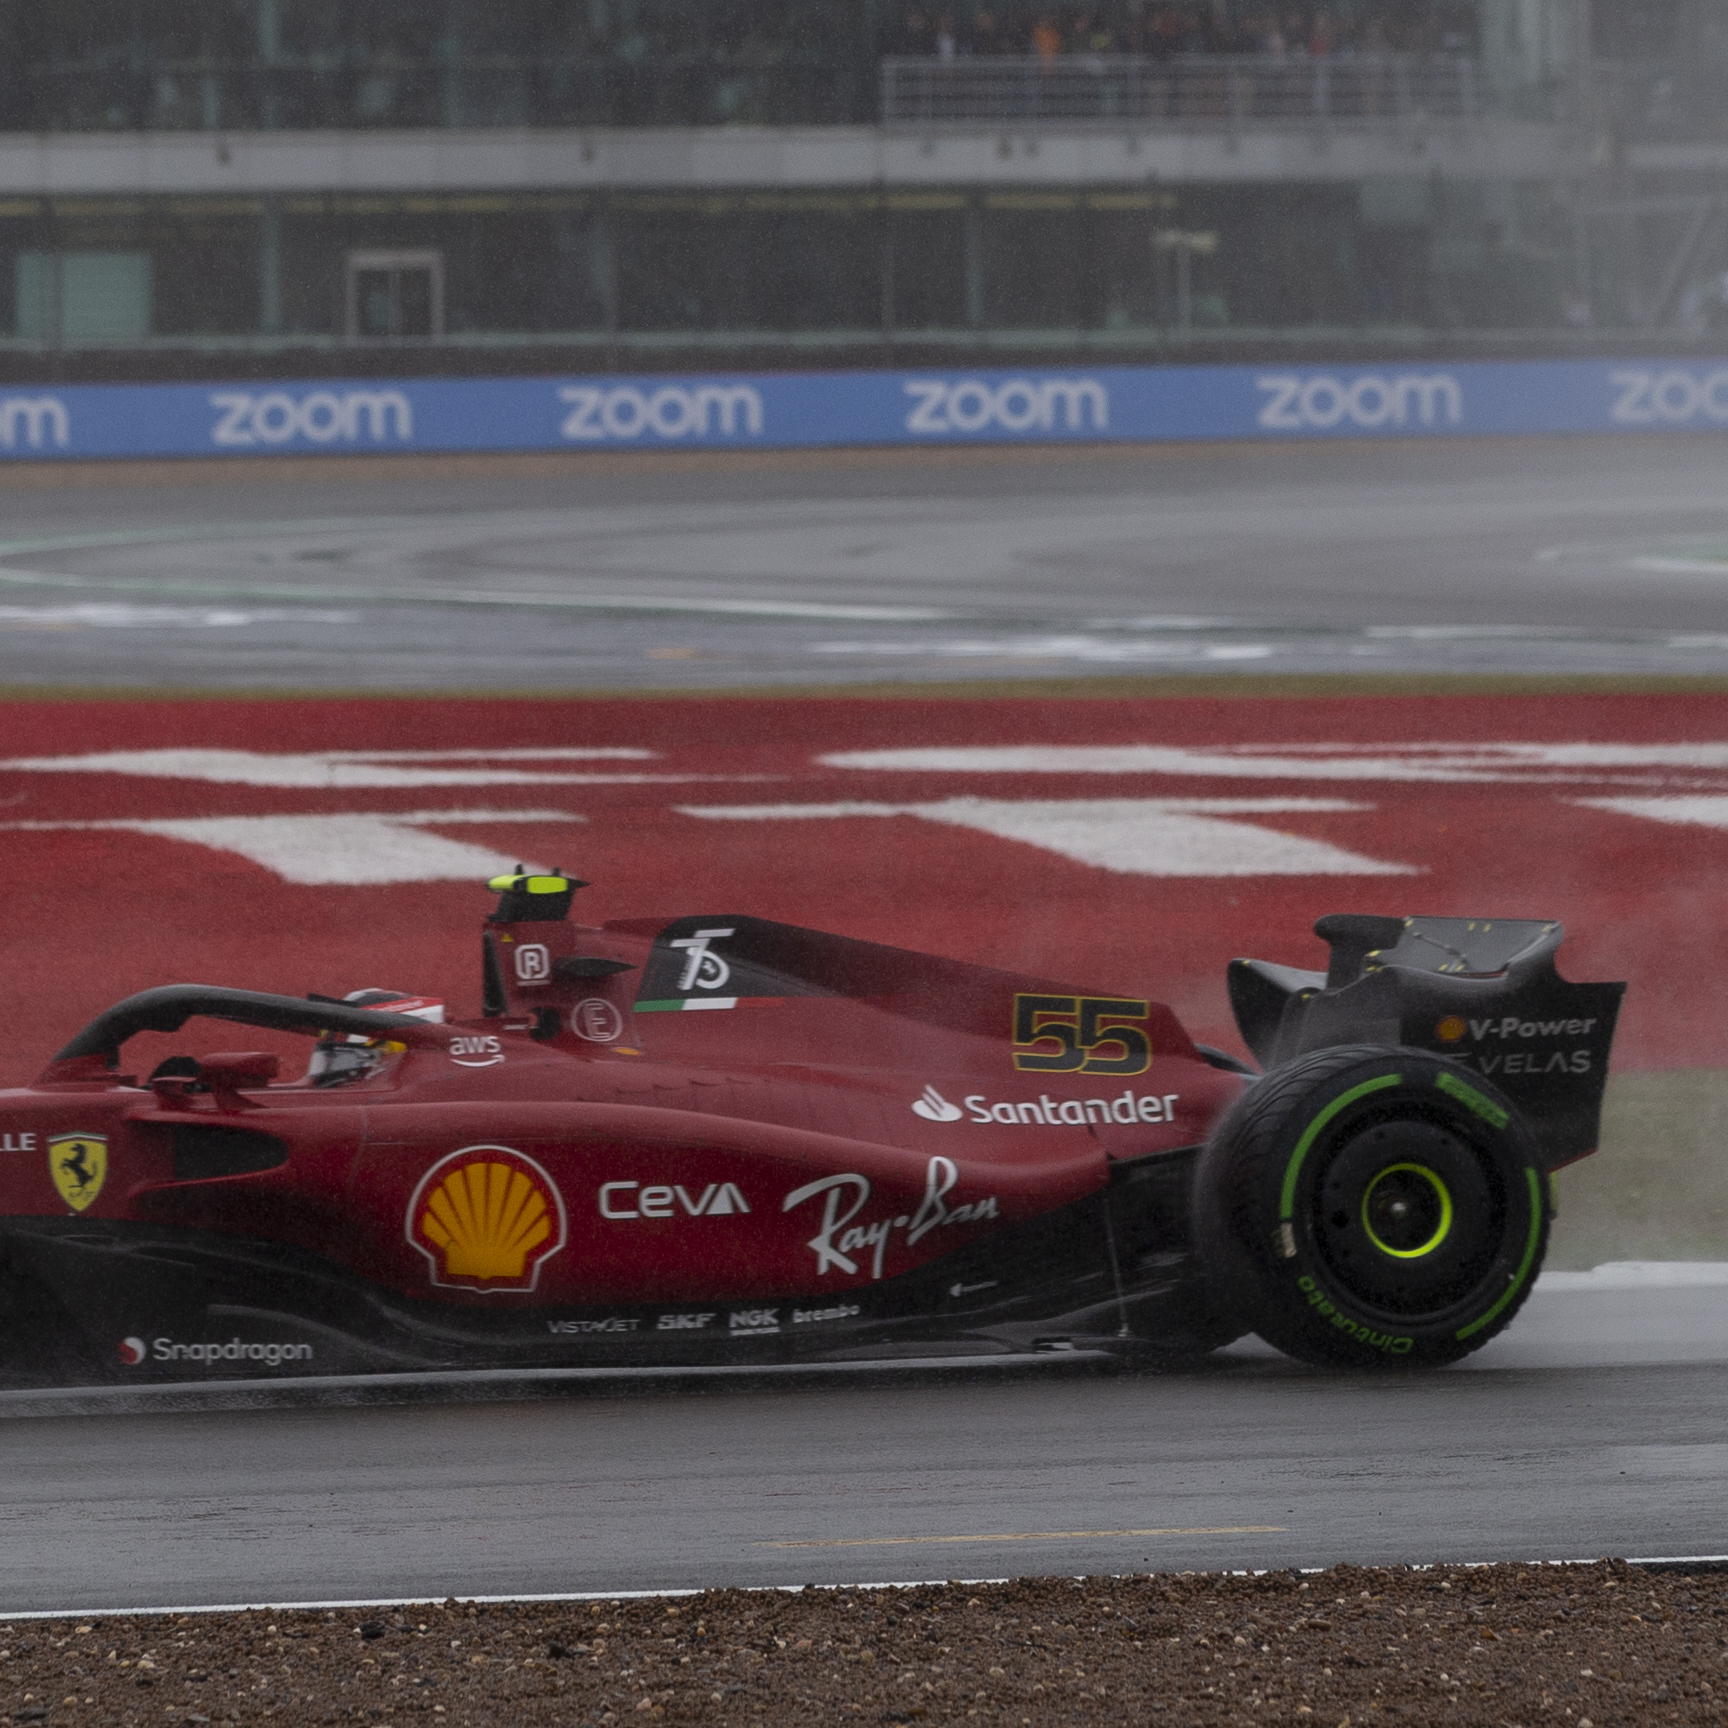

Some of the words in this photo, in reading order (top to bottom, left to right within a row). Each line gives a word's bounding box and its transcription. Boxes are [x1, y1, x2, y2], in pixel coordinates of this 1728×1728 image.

[212, 391, 410, 443] zoom
[561, 386, 761, 438] zoom
[906, 380, 1107, 431] zoom
[1259, 375, 1461, 427] zoom
[449, 1035, 501, 1056] aws
[1012, 993, 1152, 1076] 55
[1469, 1017, 1596, 1041] V-Power
[1479, 1050, 1591, 1074] VELAS
[964, 1090, 1179, 1126] Santander
[656, 1313, 716, 1329] SKF
[729, 1308, 780, 1328] NGK
[792, 1303, 861, 1323] brembo
[1297, 1275, 1414, 1354] Cinturato
[152, 1337, 313, 1366] Snapdragon
